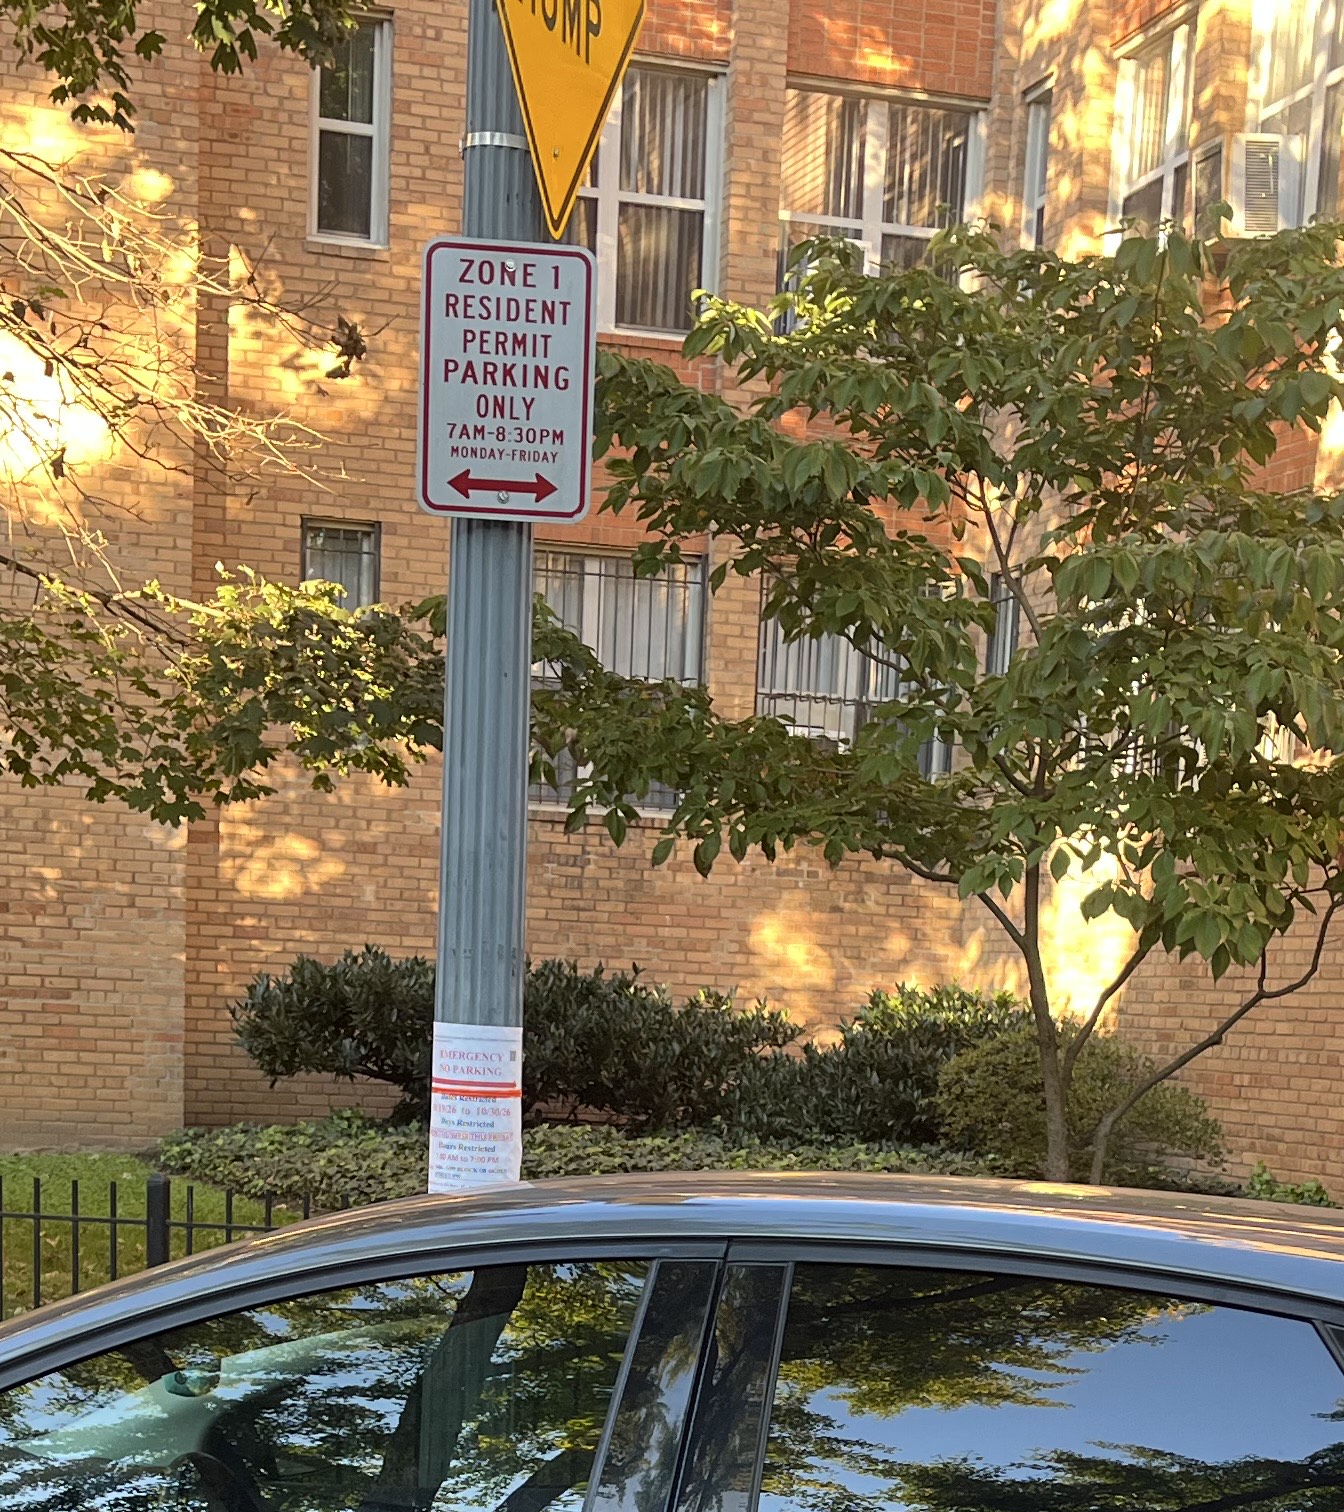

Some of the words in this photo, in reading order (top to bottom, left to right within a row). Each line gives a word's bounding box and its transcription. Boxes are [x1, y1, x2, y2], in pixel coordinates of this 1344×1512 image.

[519, 0, 602, 65] MP
[458, 258, 537, 288] ZONE
[551, 265, 560, 290] 1
[444, 293, 571, 326] RESIDENT
[462, 329, 552, 358] PERMIT
[443, 358, 570, 391] PARKING
[476, 394, 535, 421] ONLY
[446, 423, 564, 446] 7AM-8:30PM
[450, 446, 559, 464] MONDAY-FRIDAY
[440, 1050, 504, 1062] EMERGENCY
[453, 1065, 501, 1076] PARKING
